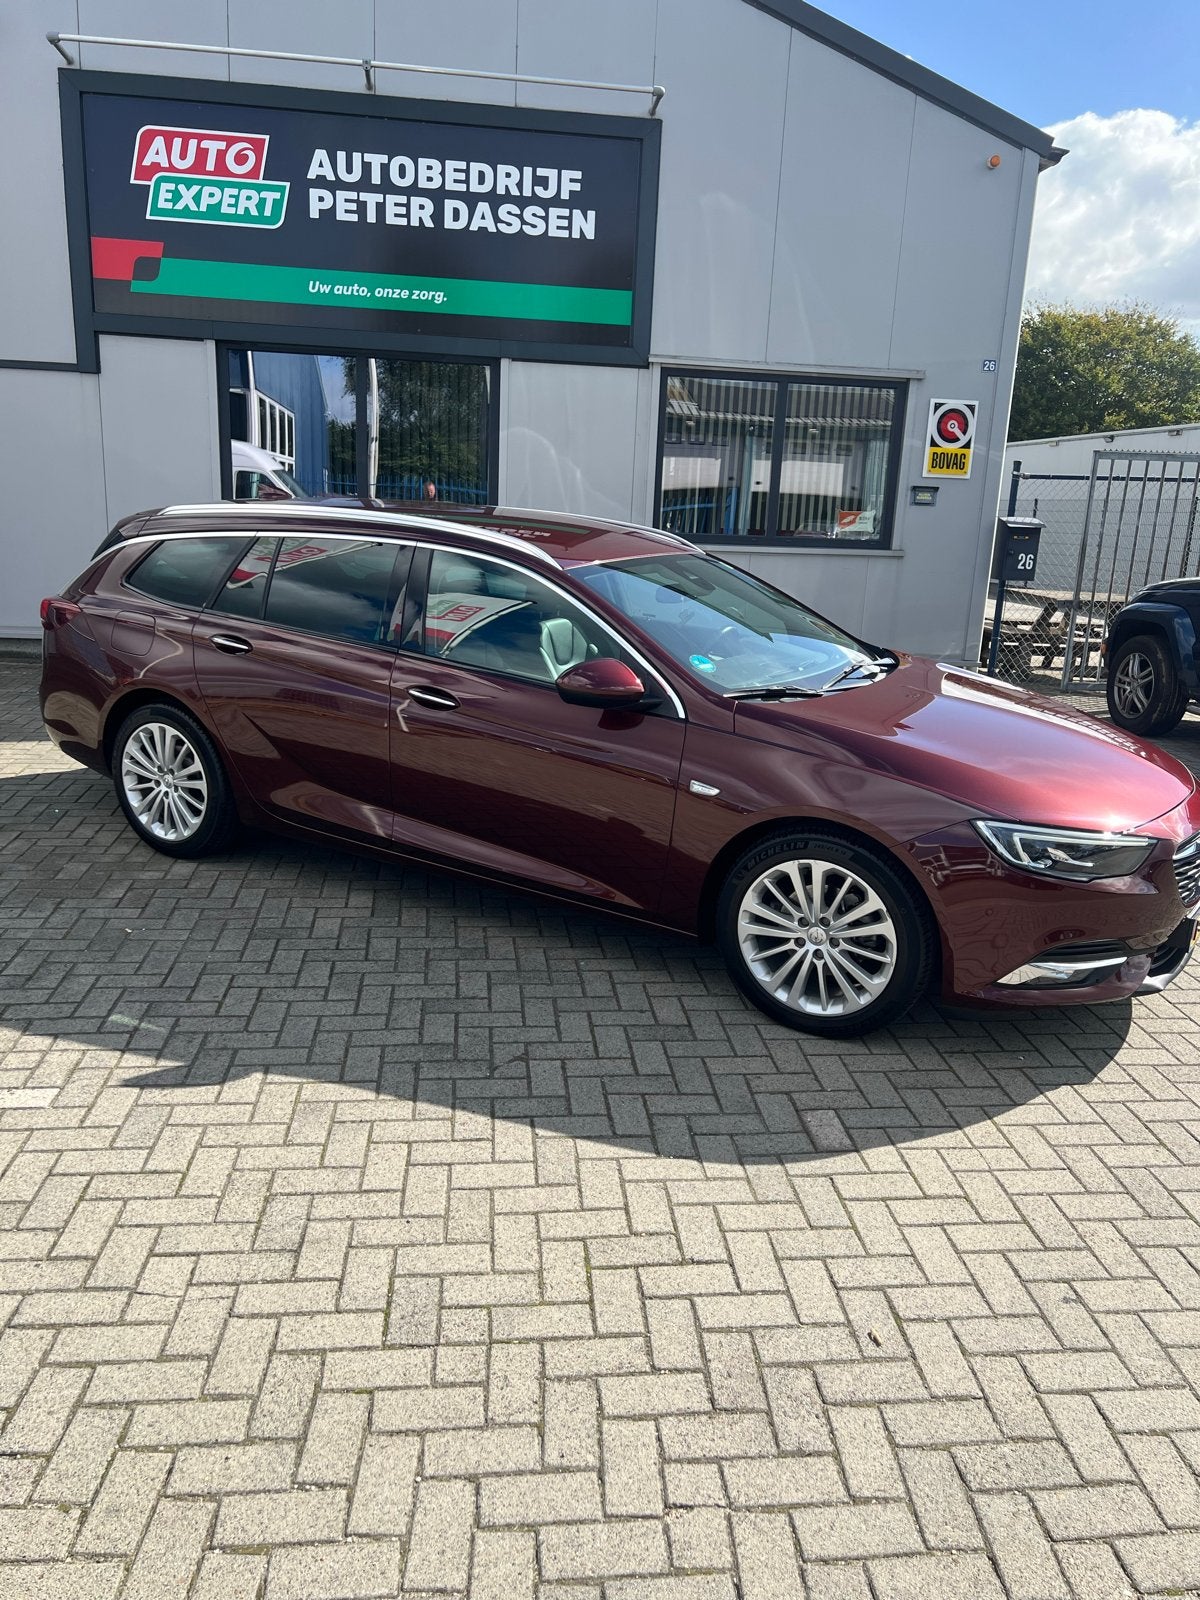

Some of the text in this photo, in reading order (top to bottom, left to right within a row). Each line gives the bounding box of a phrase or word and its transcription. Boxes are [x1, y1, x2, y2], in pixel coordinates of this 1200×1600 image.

[142, 135, 256, 175] AUTO
[306, 148, 582, 200] AUTOBEDRIJF
[157, 182, 281, 217] EXPERT
[308, 187, 596, 240] PETER DASSEN
[308, 280, 448, 304] Uw auto, onze zorg.
[983, 360, 996, 371] 26
[930, 451, 967, 471] BOVAG
[1017, 553, 1034, 570] 26
[747, 841, 806, 870] MICHELIN
